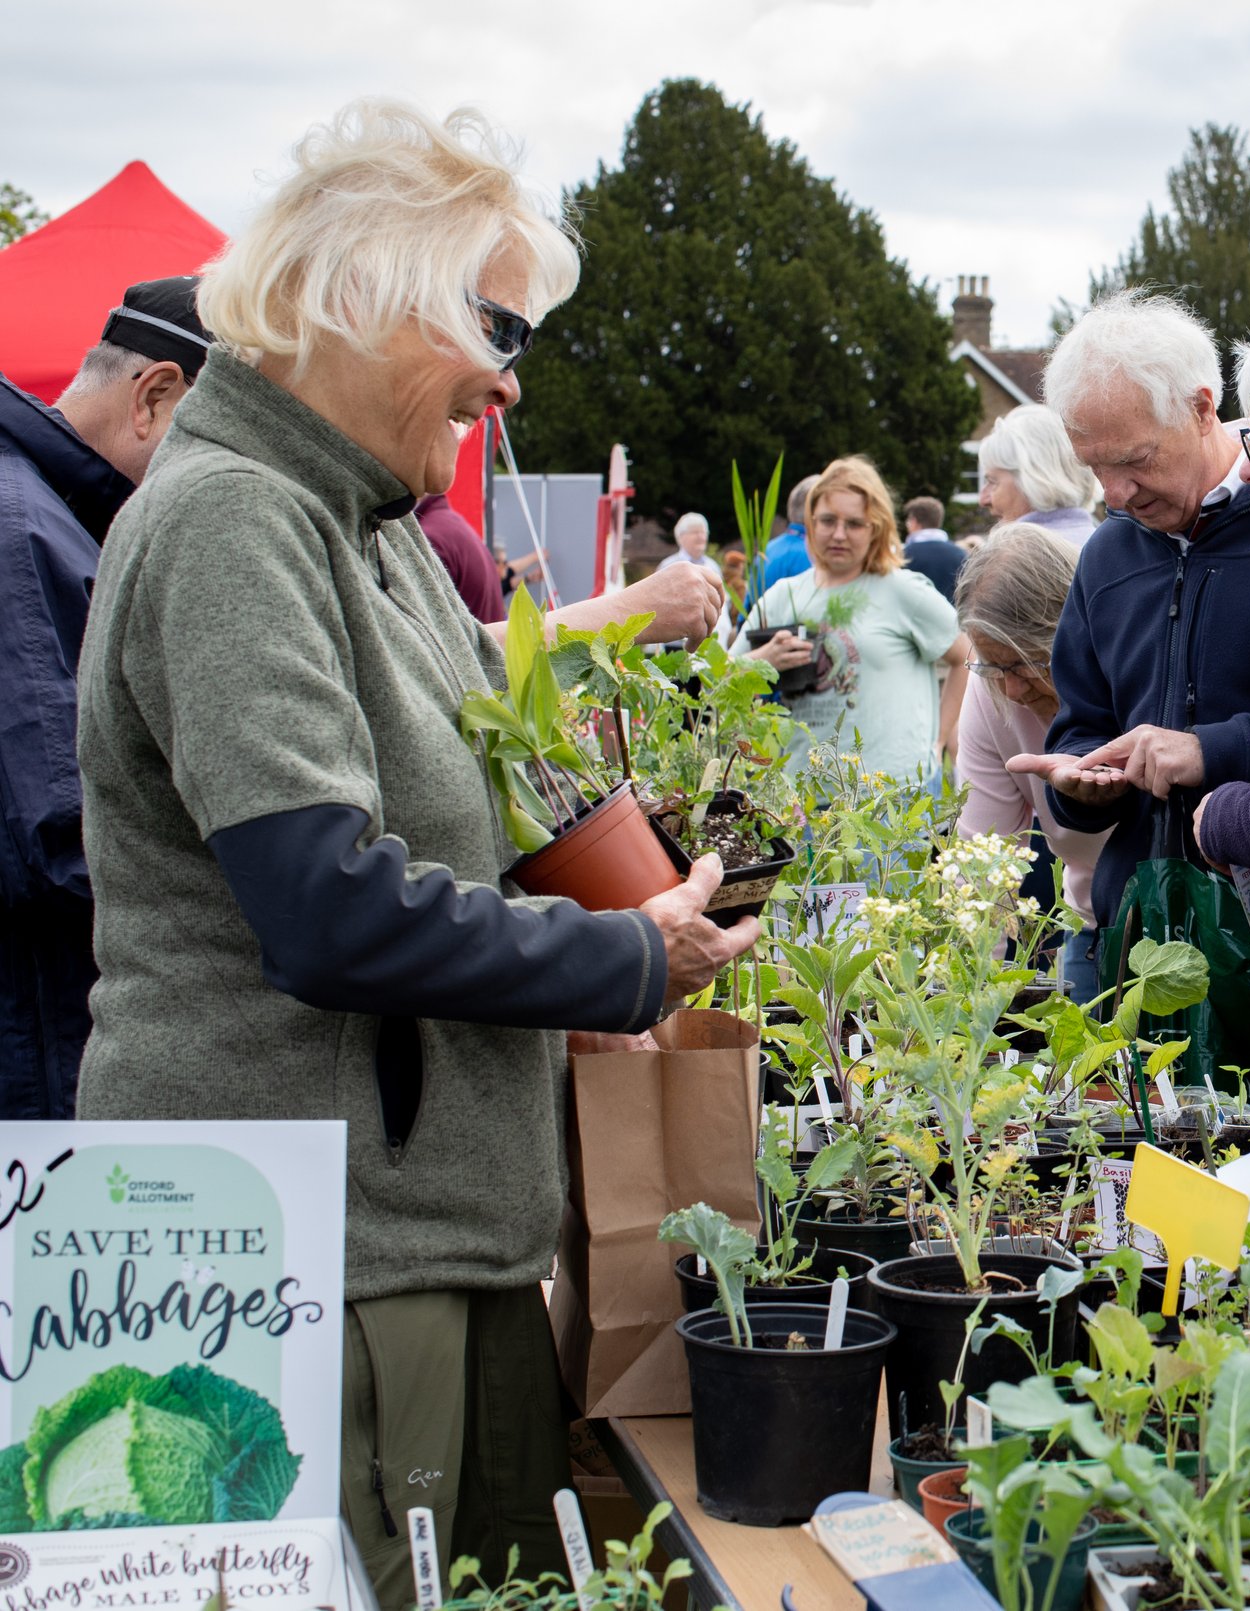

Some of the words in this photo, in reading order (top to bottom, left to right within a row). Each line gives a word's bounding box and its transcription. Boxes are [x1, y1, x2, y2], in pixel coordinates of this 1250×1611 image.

[1102, 1166, 1132, 1179] Basil
[128, 1181, 176, 1191] OTFORD
[128, 1193, 194, 1203] ALLOTMENT
[32, 1228, 153, 1258] SAVE
[166, 1226, 268, 1256] THE
[99, 1551, 176, 1587] white
[182, 1543, 314, 1581] butterfly
[93, 1588, 181, 1609] MALE
[195, 1581, 311, 1601] DECOYS
